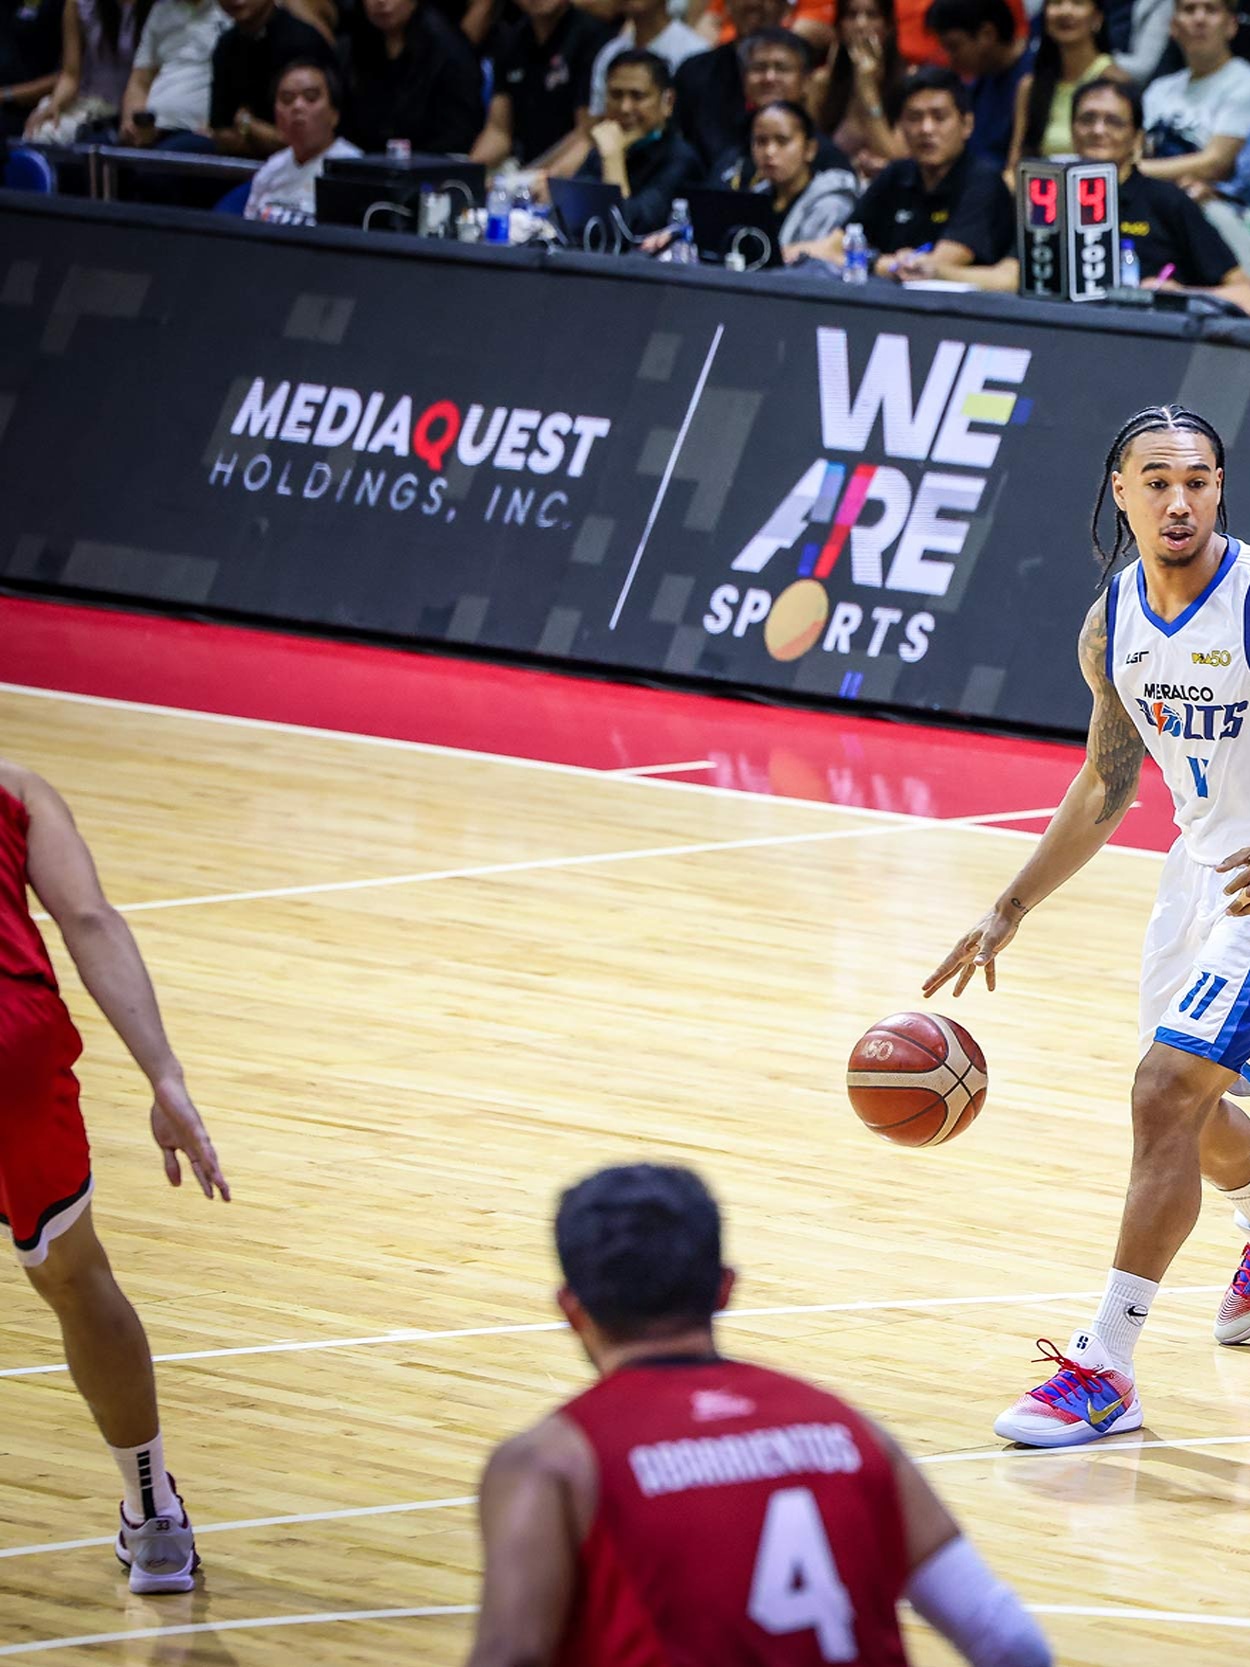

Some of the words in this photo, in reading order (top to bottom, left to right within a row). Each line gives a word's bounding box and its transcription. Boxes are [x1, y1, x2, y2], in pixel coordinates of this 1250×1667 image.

[1028, 177, 1058, 224] 4
[1077, 177, 1106, 223] 4
[1080, 230, 1107, 297] FOUL
[815, 325, 1033, 468] WE
[230, 375, 612, 479] MEDIAQUEST
[484, 485, 574, 531] INC.
[730, 457, 988, 596] ARE
[1143, 683, 1214, 703] MERALCO
[1178, 971, 1229, 1021] 11
[745, 1485, 859, 1664] 4
